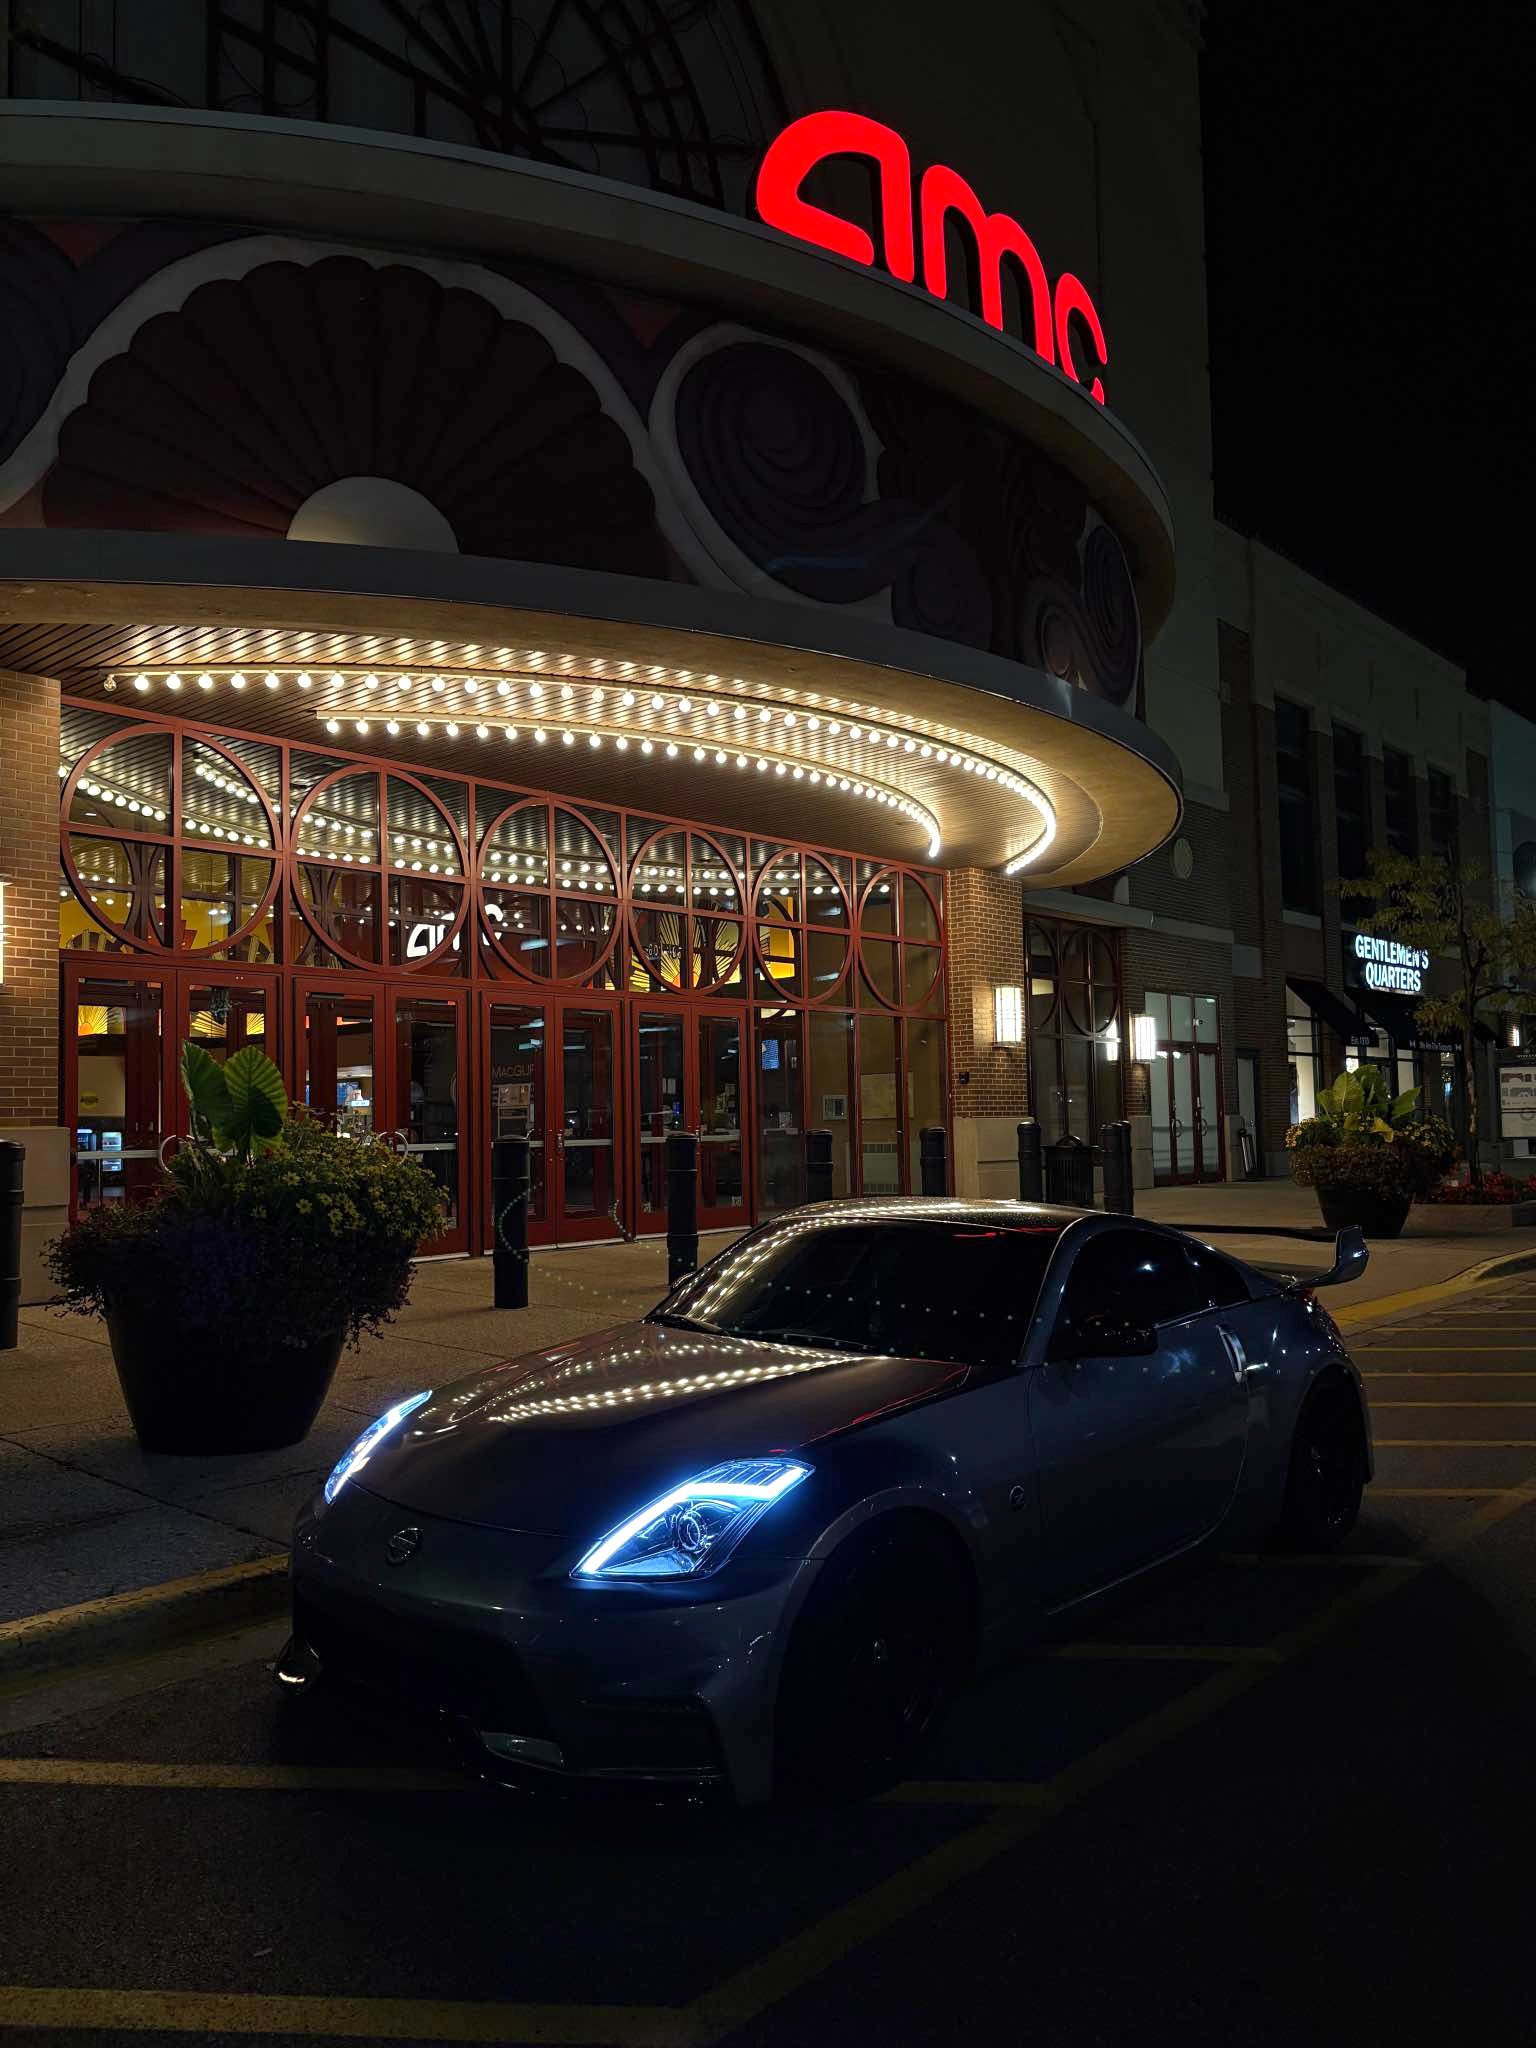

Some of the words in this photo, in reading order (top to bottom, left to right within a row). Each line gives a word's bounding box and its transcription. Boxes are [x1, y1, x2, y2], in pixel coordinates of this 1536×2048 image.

[756, 110, 1107, 406] amc
[1354, 934, 1429, 970] GENTLEMEN'S
[1365, 961, 1421, 992] QUARTERS
